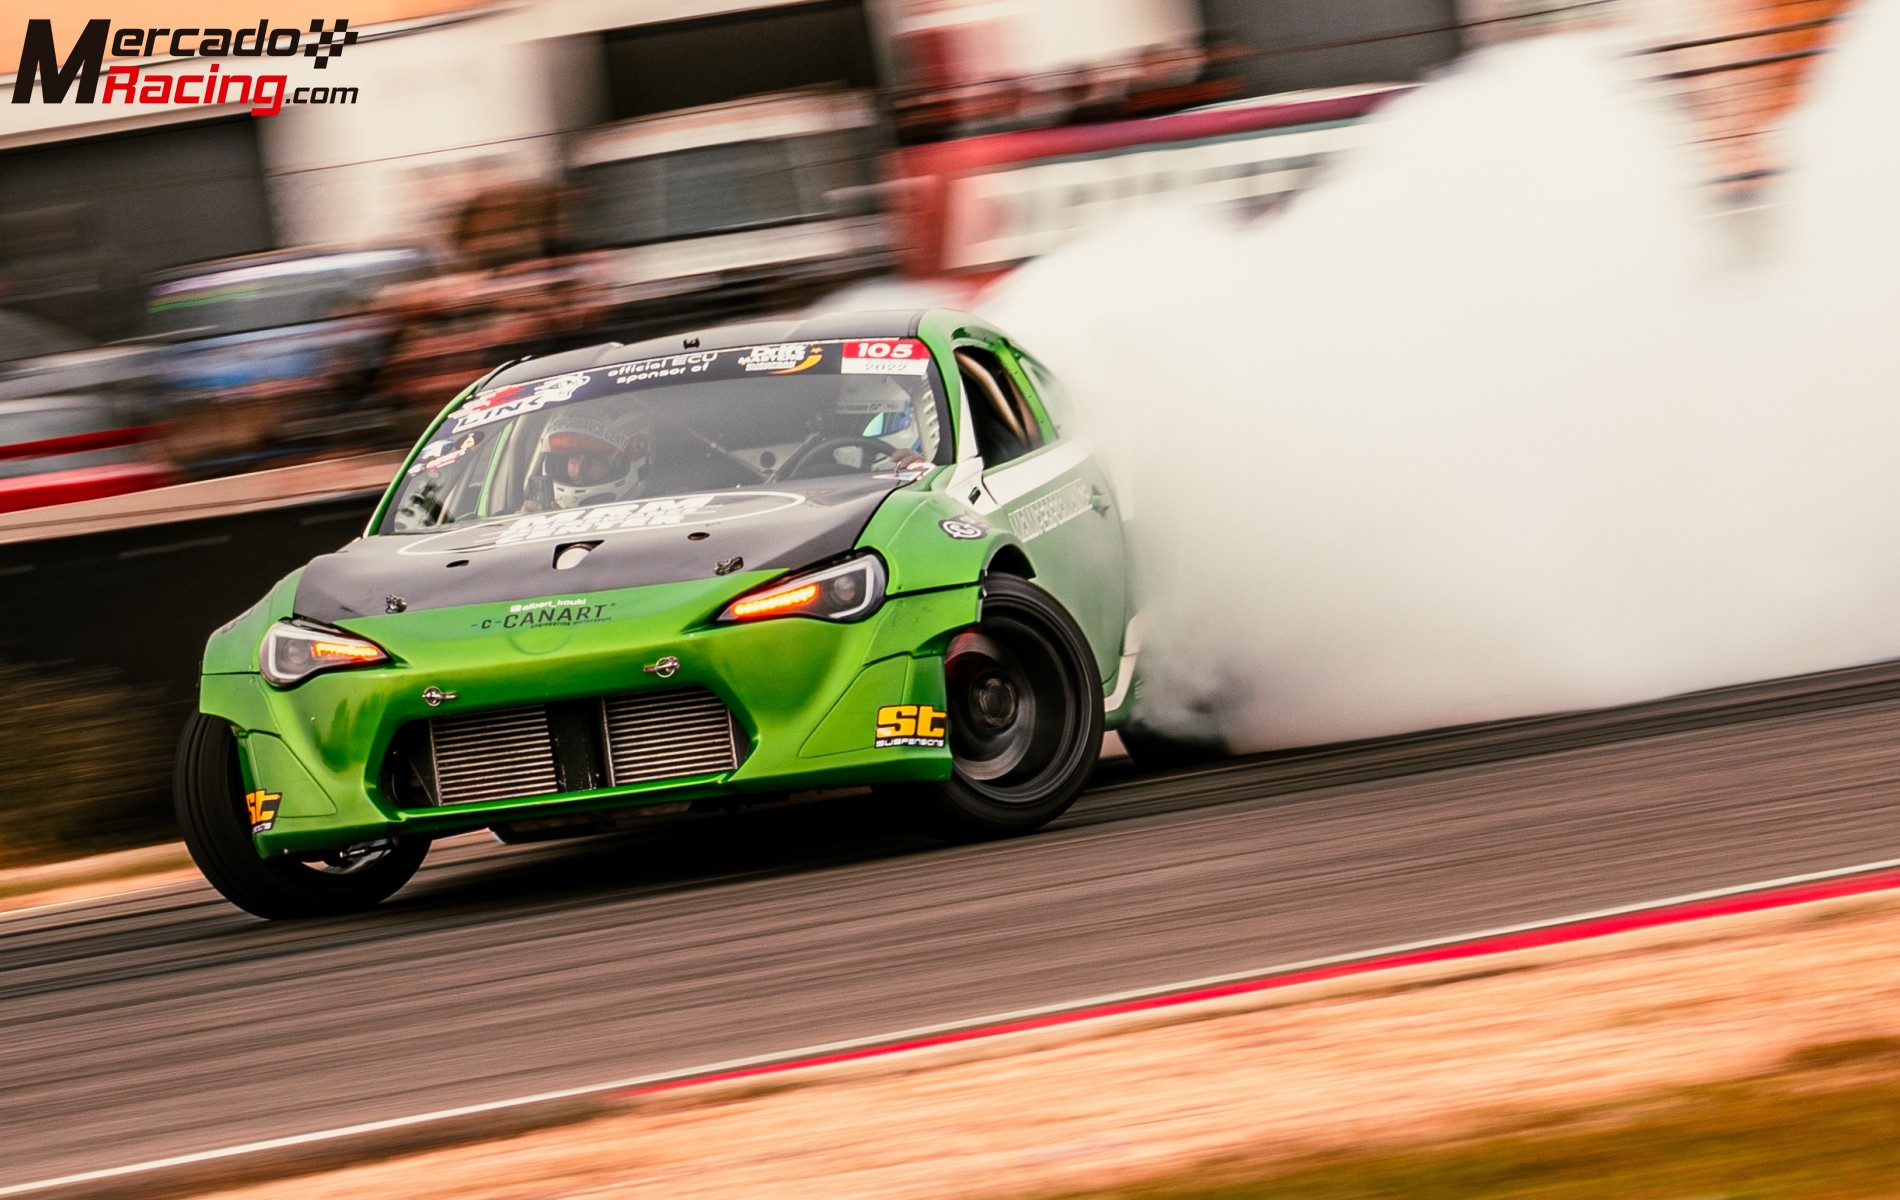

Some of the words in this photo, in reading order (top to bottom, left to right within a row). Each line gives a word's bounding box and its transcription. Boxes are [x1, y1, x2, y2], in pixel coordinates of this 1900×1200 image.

[858, 343, 913, 358] 105
[608, 359, 667, 377] official
[672, 353, 718, 366] ECU
[617, 367, 686, 384] sponsor
[691, 362, 710, 373] of
